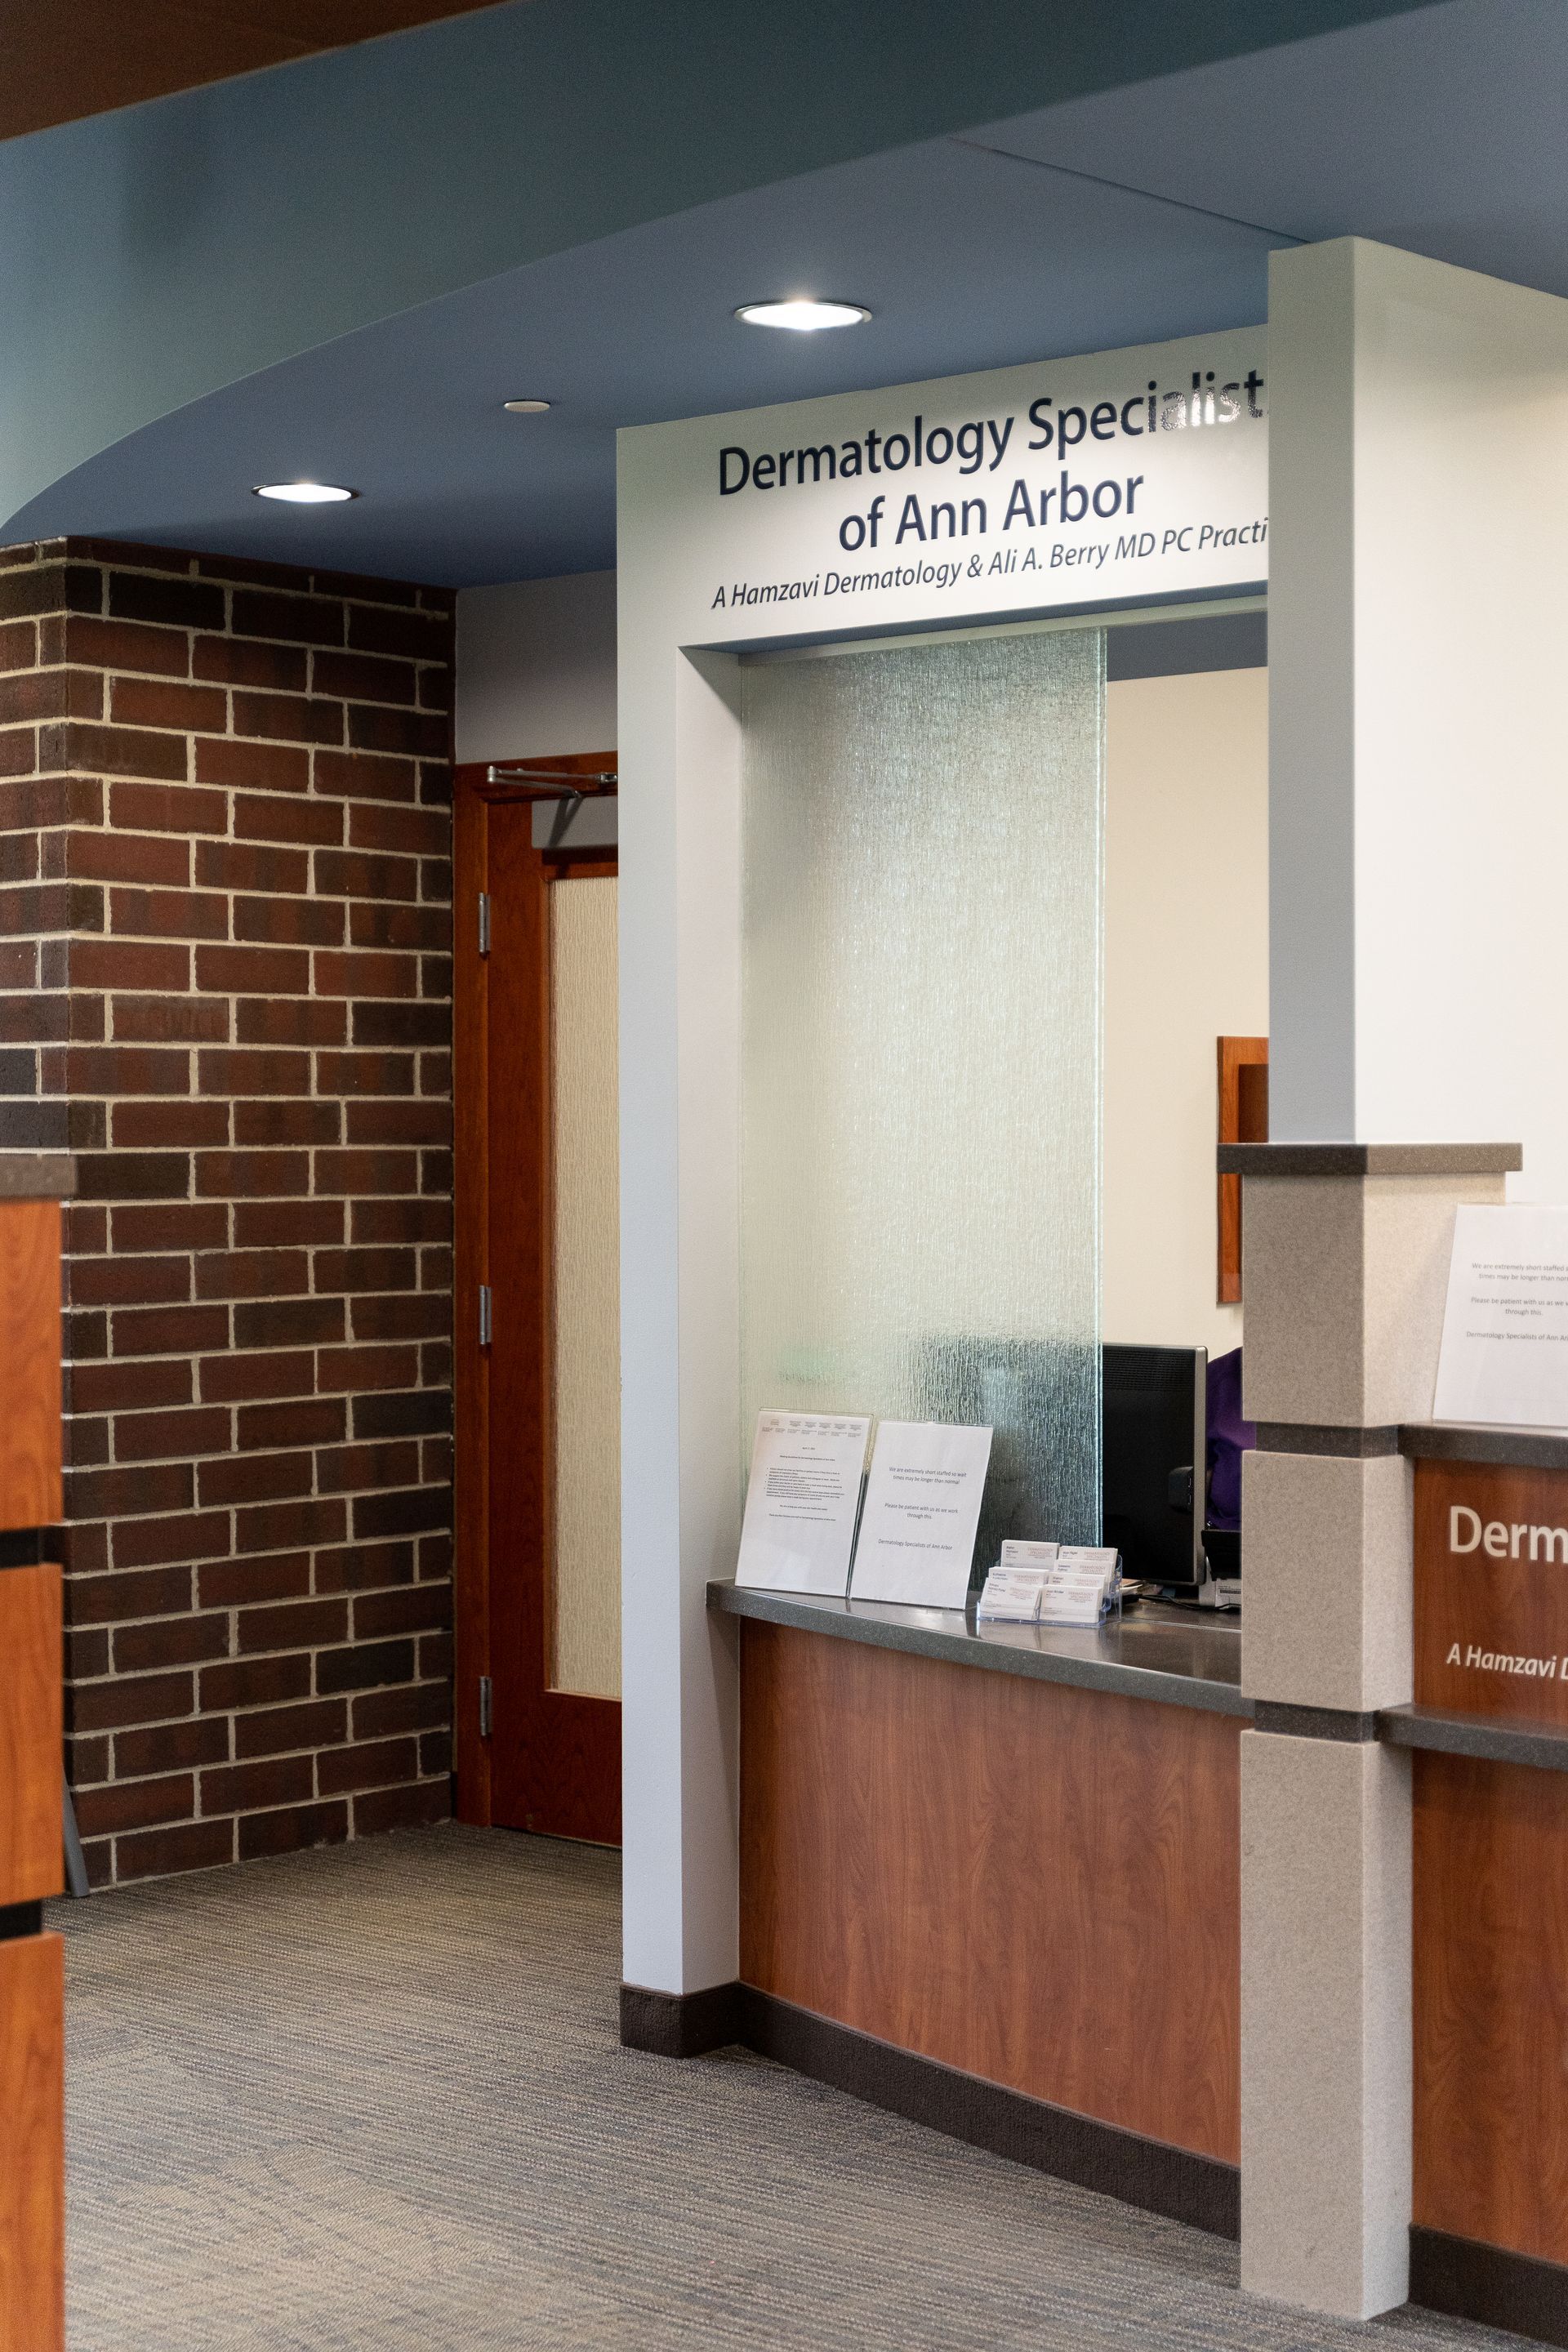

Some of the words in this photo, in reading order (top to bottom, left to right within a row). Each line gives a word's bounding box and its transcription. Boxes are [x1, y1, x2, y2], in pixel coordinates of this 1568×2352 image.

[719, 414, 1014, 496] Dermatology
[1027, 370, 1268, 460] Specialist
[839, 495, 884, 551] of
[895, 493, 987, 545] Ann
[1002, 470, 1144, 531] Arbor
[711, 586, 729, 610] A
[731, 573, 820, 608] Hamzavi
[823, 558, 962, 598] Dermatology
[968, 554, 982, 577] &
[988, 546, 1018, 573] Ali
[1021, 547, 1043, 571] A.
[1049, 541, 1110, 569] Berry
[1116, 535, 1156, 557] MD
[1161, 526, 1194, 554] PC
[1467, 1331, 1505, 1339] Dermatology
[1450, 1506, 1568, 1564] Derm
[1446, 1643, 1460, 1665] A
[1466, 1645, 1557, 1678] Hamzavi
